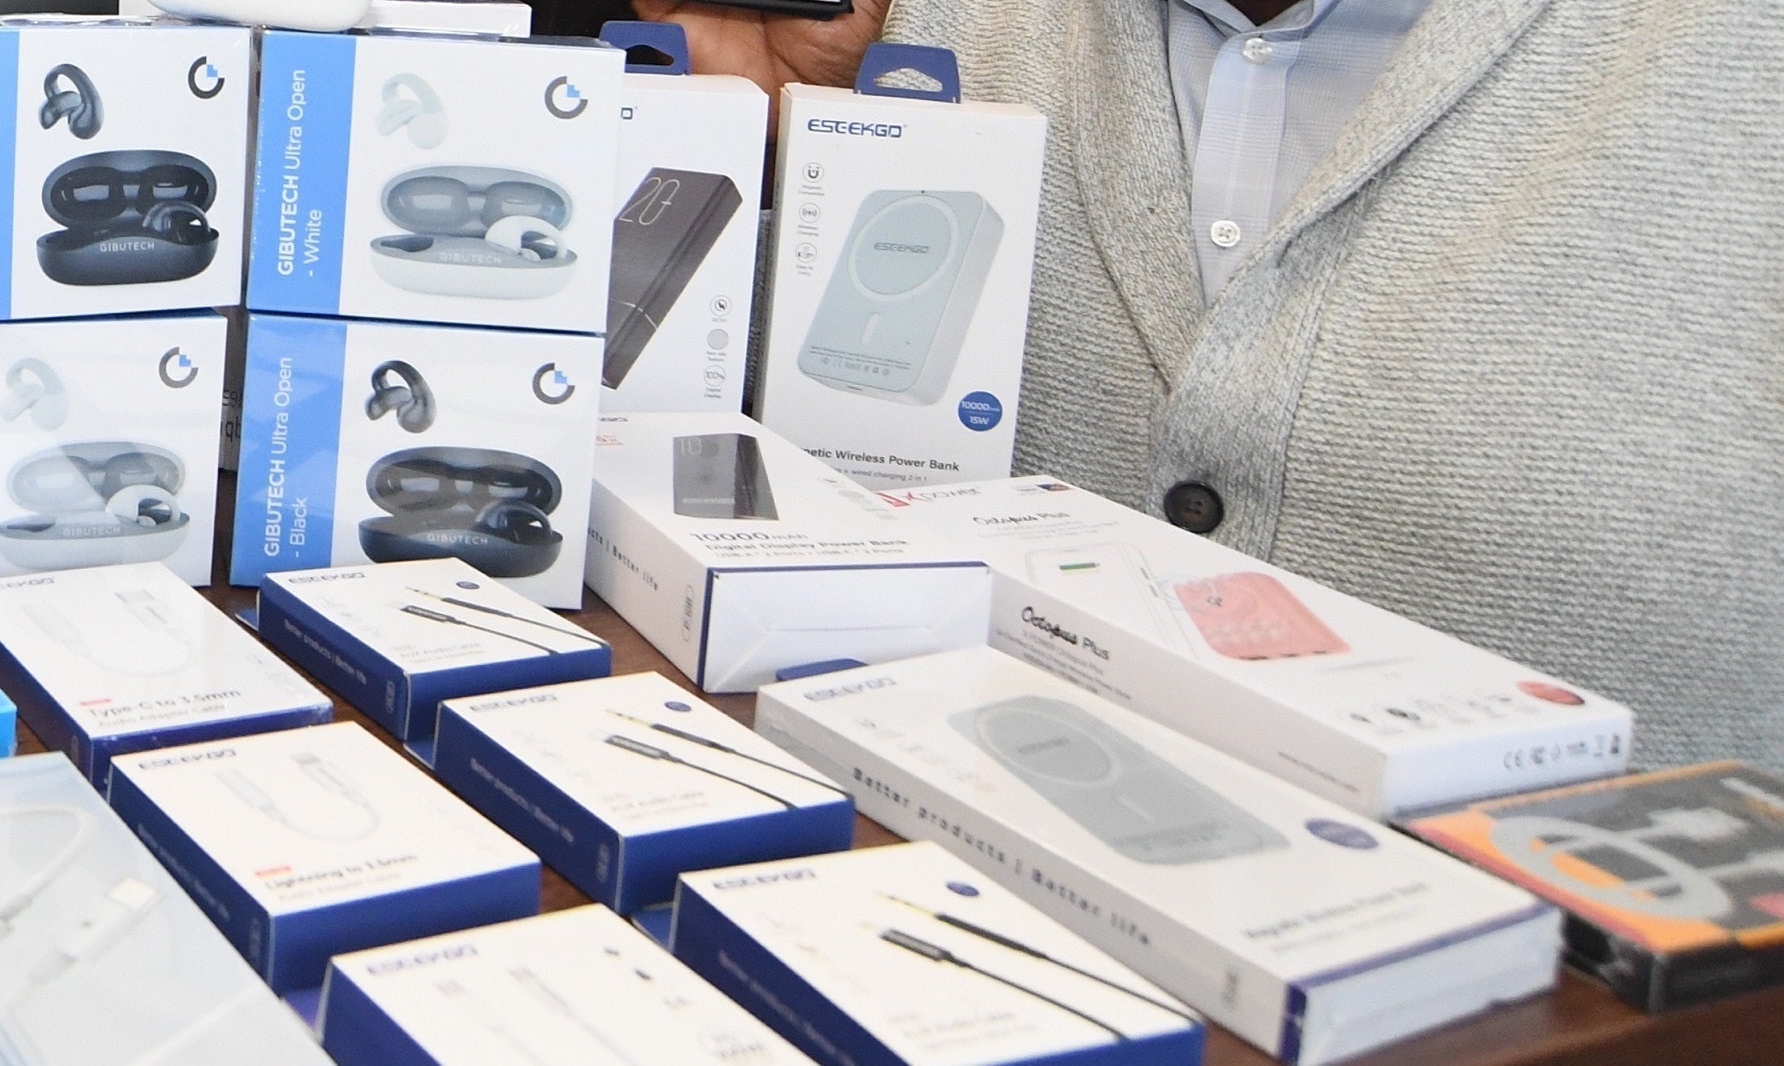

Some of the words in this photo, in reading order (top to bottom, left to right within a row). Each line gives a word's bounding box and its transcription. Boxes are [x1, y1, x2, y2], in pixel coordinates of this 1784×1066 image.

[287, 69, 306, 119] Open
[283, 124, 302, 170] Ultra
[807, 118, 902, 139] ESEEKGO
[278, 174, 298, 276] GIBUTECH
[304, 209, 323, 267] White
[99, 241, 155, 253] GIBUTECH
[439, 252, 502, 264] GIBUTECH
[275, 357, 293, 406] Open
[272, 411, 288, 453] Ultra
[835, 450, 885, 464] Wireless
[889, 456, 925, 468] Power
[929, 459, 960, 471] Bank
[874, 472, 906, 481] charging
[264, 457, 285, 557] GIBUTECH
[290, 497, 307, 546] Black
[426, 534, 488, 546] GIBUTECH
[1082, 635, 1110, 661] Plus
[181, 688, 242, 705] 3.5mm
[852, 766, 910, 808] Better
[1031, 867, 1100, 916] Better
